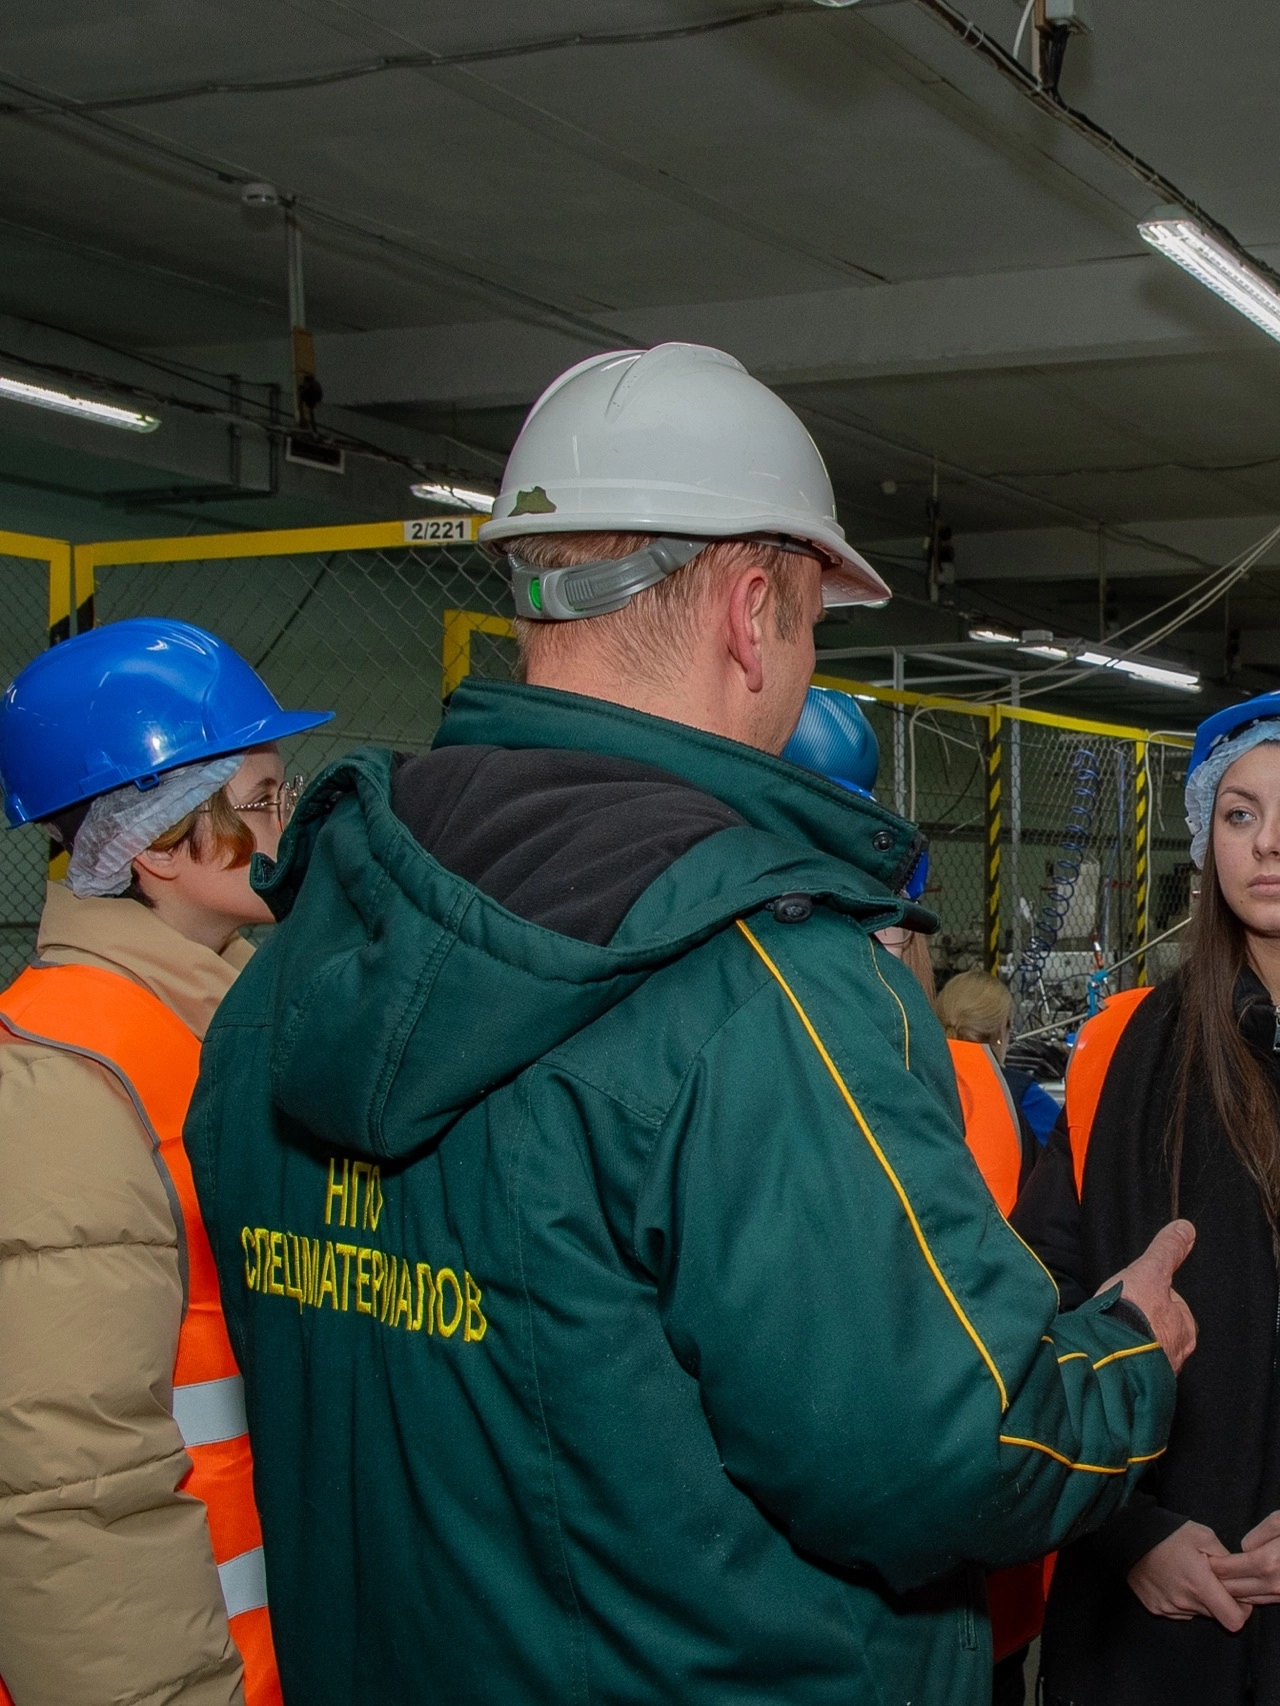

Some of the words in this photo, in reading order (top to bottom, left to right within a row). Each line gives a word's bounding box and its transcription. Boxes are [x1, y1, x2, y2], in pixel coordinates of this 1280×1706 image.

[411, 521, 465, 540] 2/221
[324, 1157, 384, 1232] НПО
[241, 1226, 488, 1342] СПЕЦМАТЕРИАЛОВ
